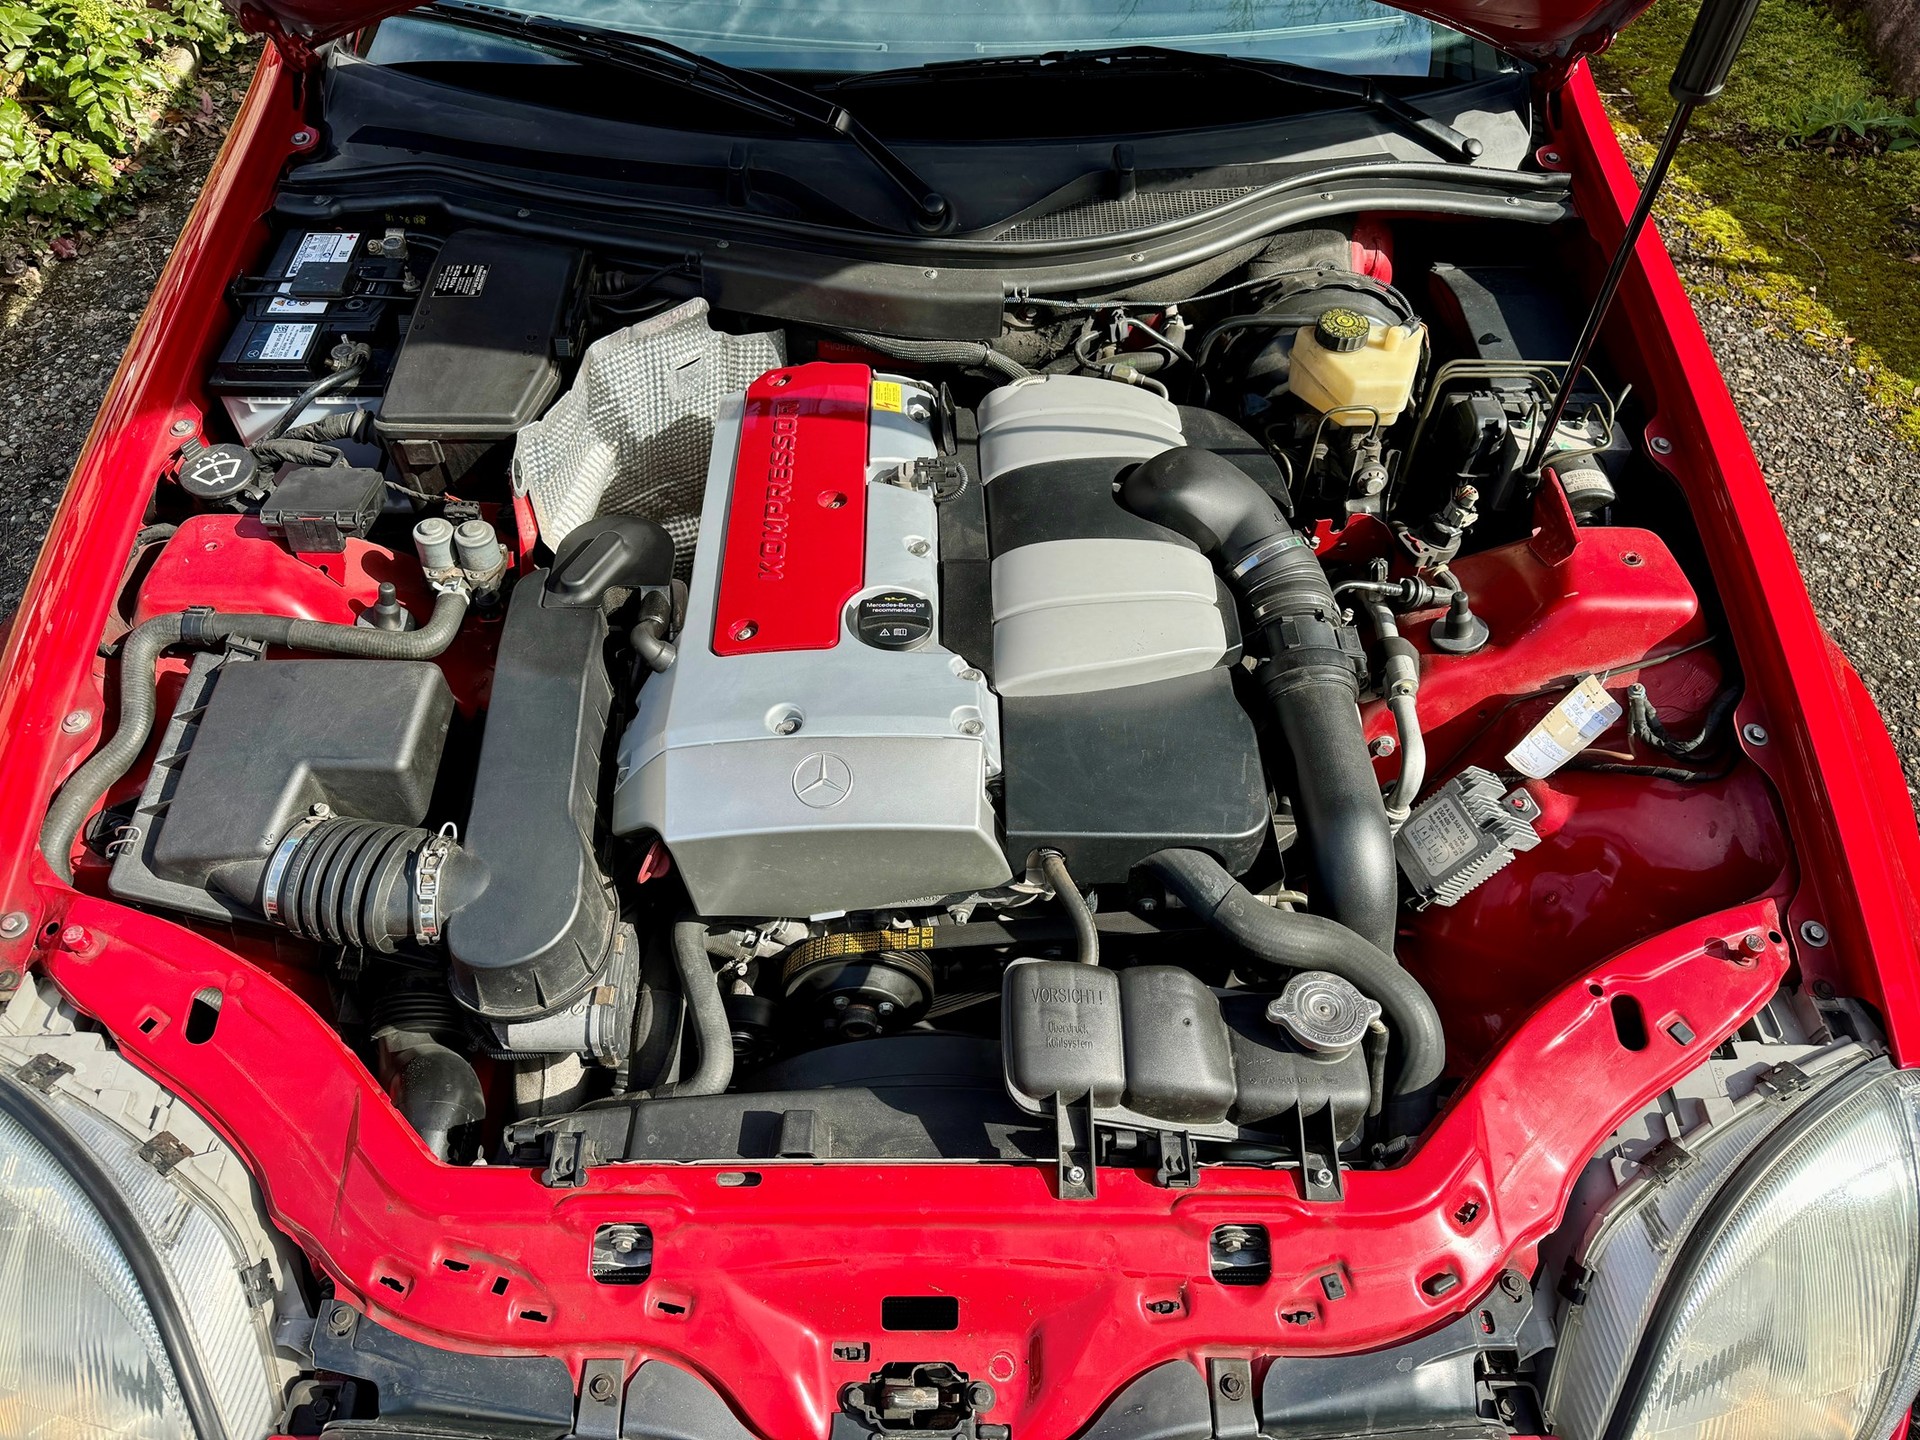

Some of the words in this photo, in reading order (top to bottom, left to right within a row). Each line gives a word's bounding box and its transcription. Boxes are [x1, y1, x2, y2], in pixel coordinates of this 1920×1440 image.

[758, 402, 799, 580] KOMPRESSOR
[1428, 814, 1437, 825] Made
[1436, 827, 1449, 844] Hungary
[1031, 988, 1103, 1005] VORSICHT!
